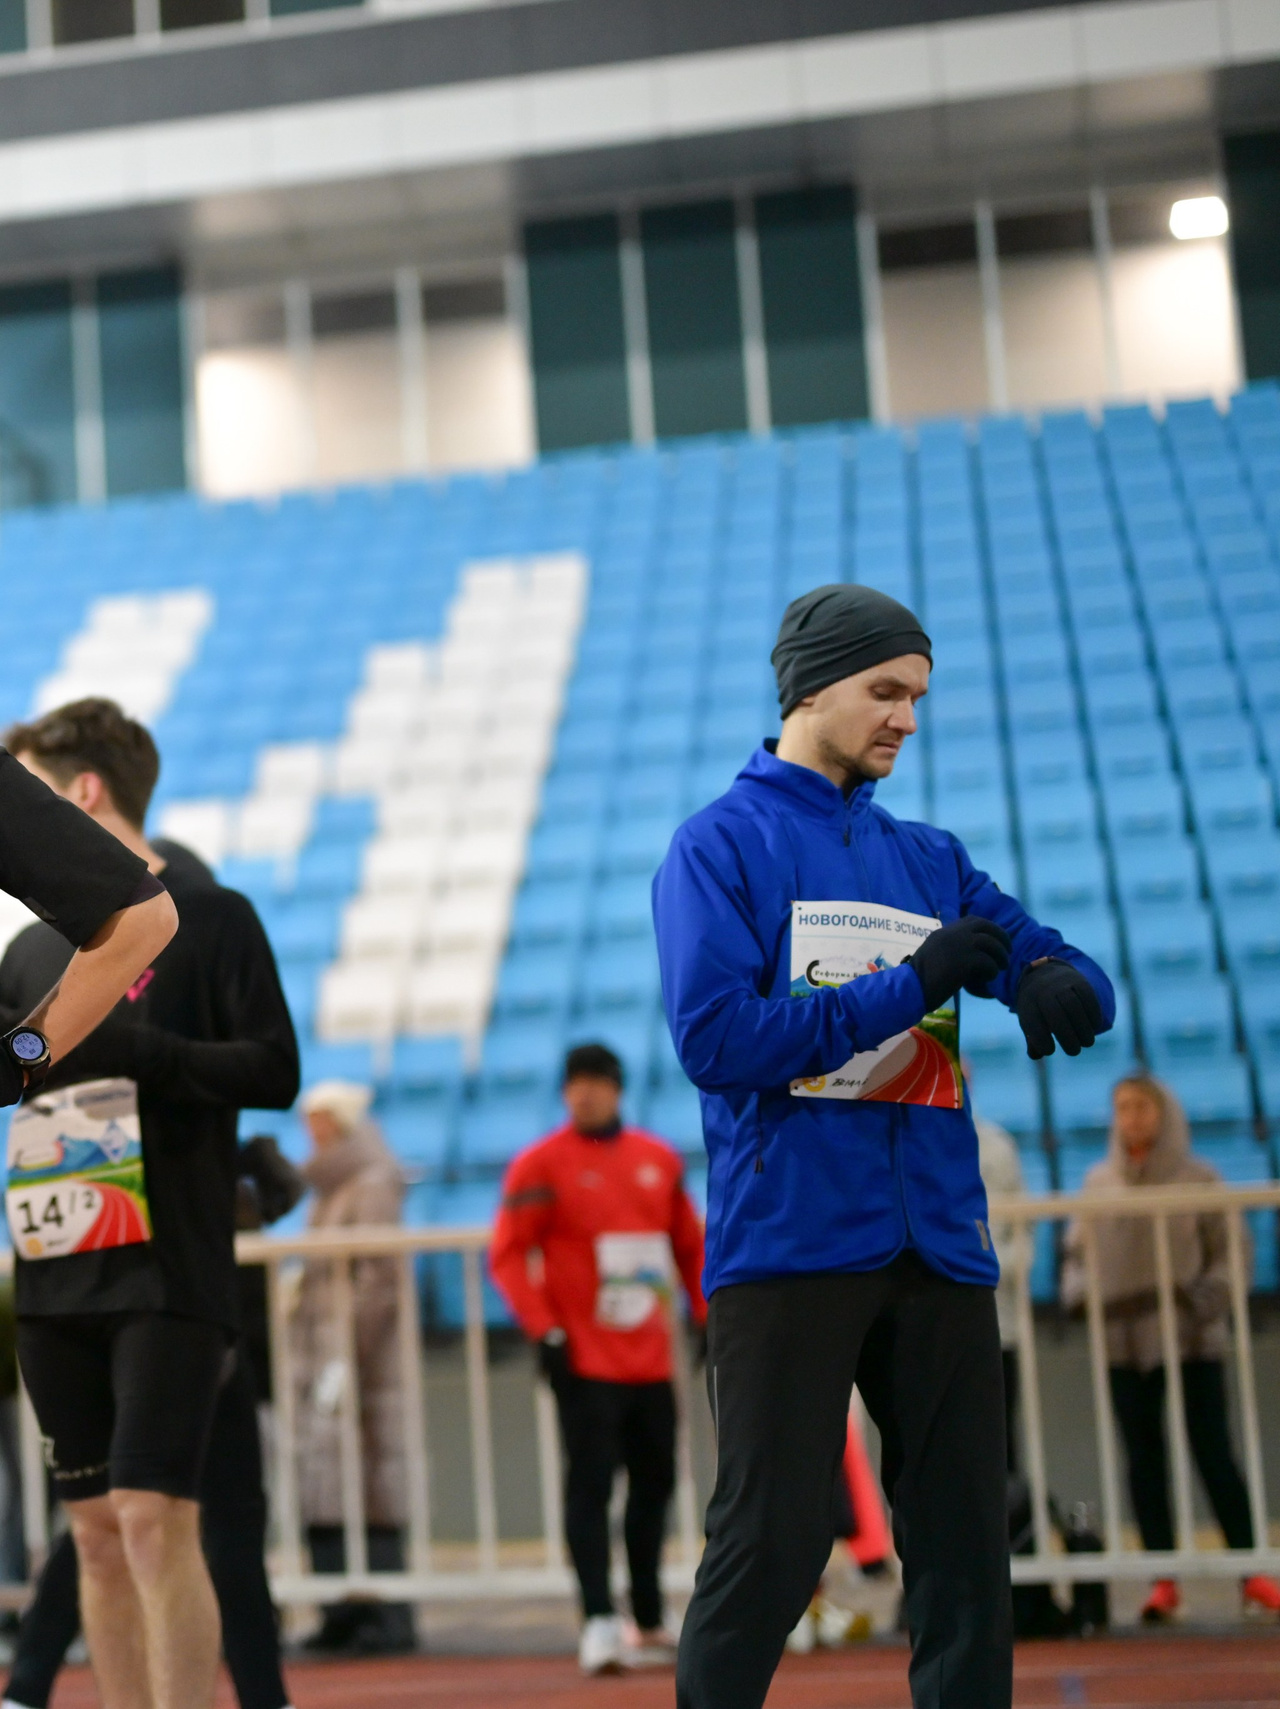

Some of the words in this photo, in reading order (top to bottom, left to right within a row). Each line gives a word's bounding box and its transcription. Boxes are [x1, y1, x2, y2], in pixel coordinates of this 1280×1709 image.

[798, 914, 892, 931] НОВОГОДНИЕ
[815, 970, 851, 979] Реформа
[17, 1194, 64, 1233] 14
